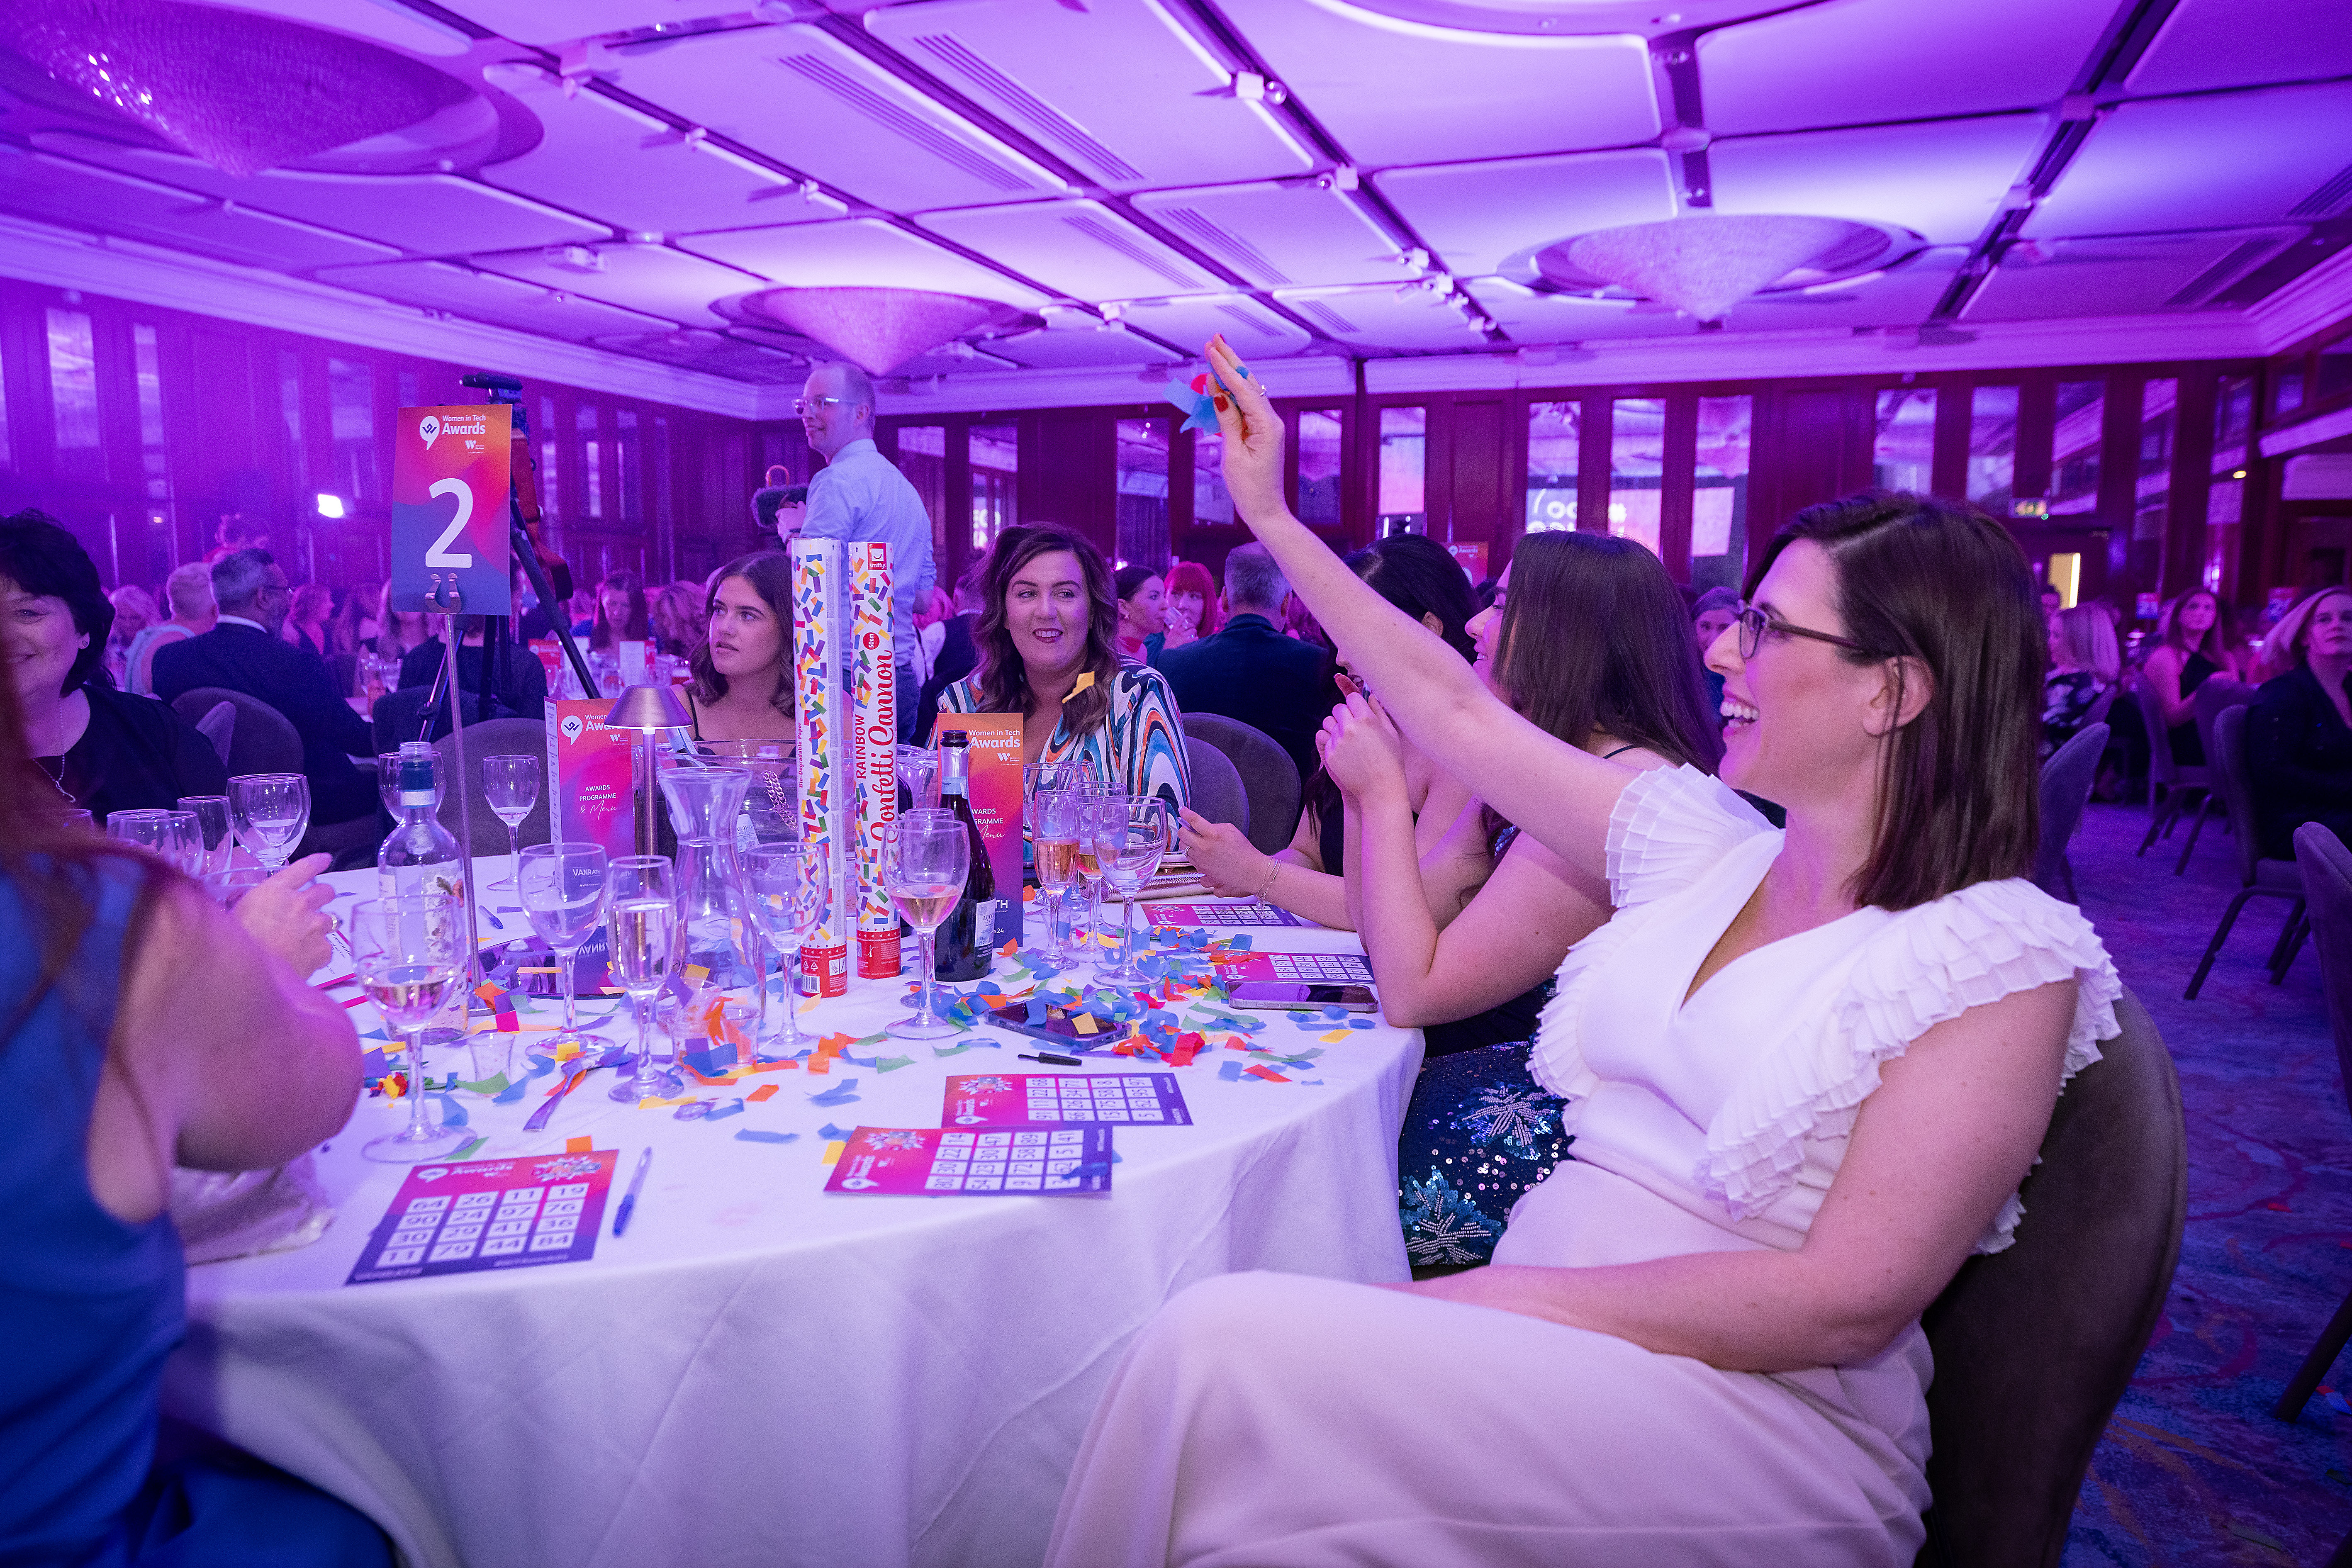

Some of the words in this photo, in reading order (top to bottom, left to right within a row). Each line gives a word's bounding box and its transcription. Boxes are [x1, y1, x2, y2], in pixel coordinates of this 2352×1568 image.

[441, 421, 486, 435] Awards
[425, 478, 473, 568] 2
[868, 650, 894, 746] Cannon
[855, 714, 867, 779] RAINBOW
[971, 736, 1020, 748] Awards
[579, 793, 616, 801] PROGRAMME
[870, 750, 899, 844] Confetti
[579, 805, 585, 813] &
[590, 800, 618, 820] Menu
[331, 934, 353, 956] Presentatio
[1228, 965, 1238, 974] Awards
[1069, 1112, 1085, 1120] 66
[948, 1134, 965, 1143] 14
[985, 1136, 1001, 1146] 47
[1058, 1132, 1075, 1142] 41
[942, 1148, 962, 1158] 22
[980, 1149, 999, 1159] 30
[1018, 1148, 1036, 1159] 58
[937, 1163, 957, 1174] 30
[976, 1164, 995, 1174] 23
[1015, 1163, 1032, 1174] 72
[413, 1200, 443, 1210] 64
[461, 1195, 491, 1205] 26
[513, 1190, 535, 1200] 11
[452, 1211, 483, 1221] 24
[491, 1222, 522, 1232] 41
[390, 1250, 415, 1261] 11
[489, 1239, 520, 1249] 44
